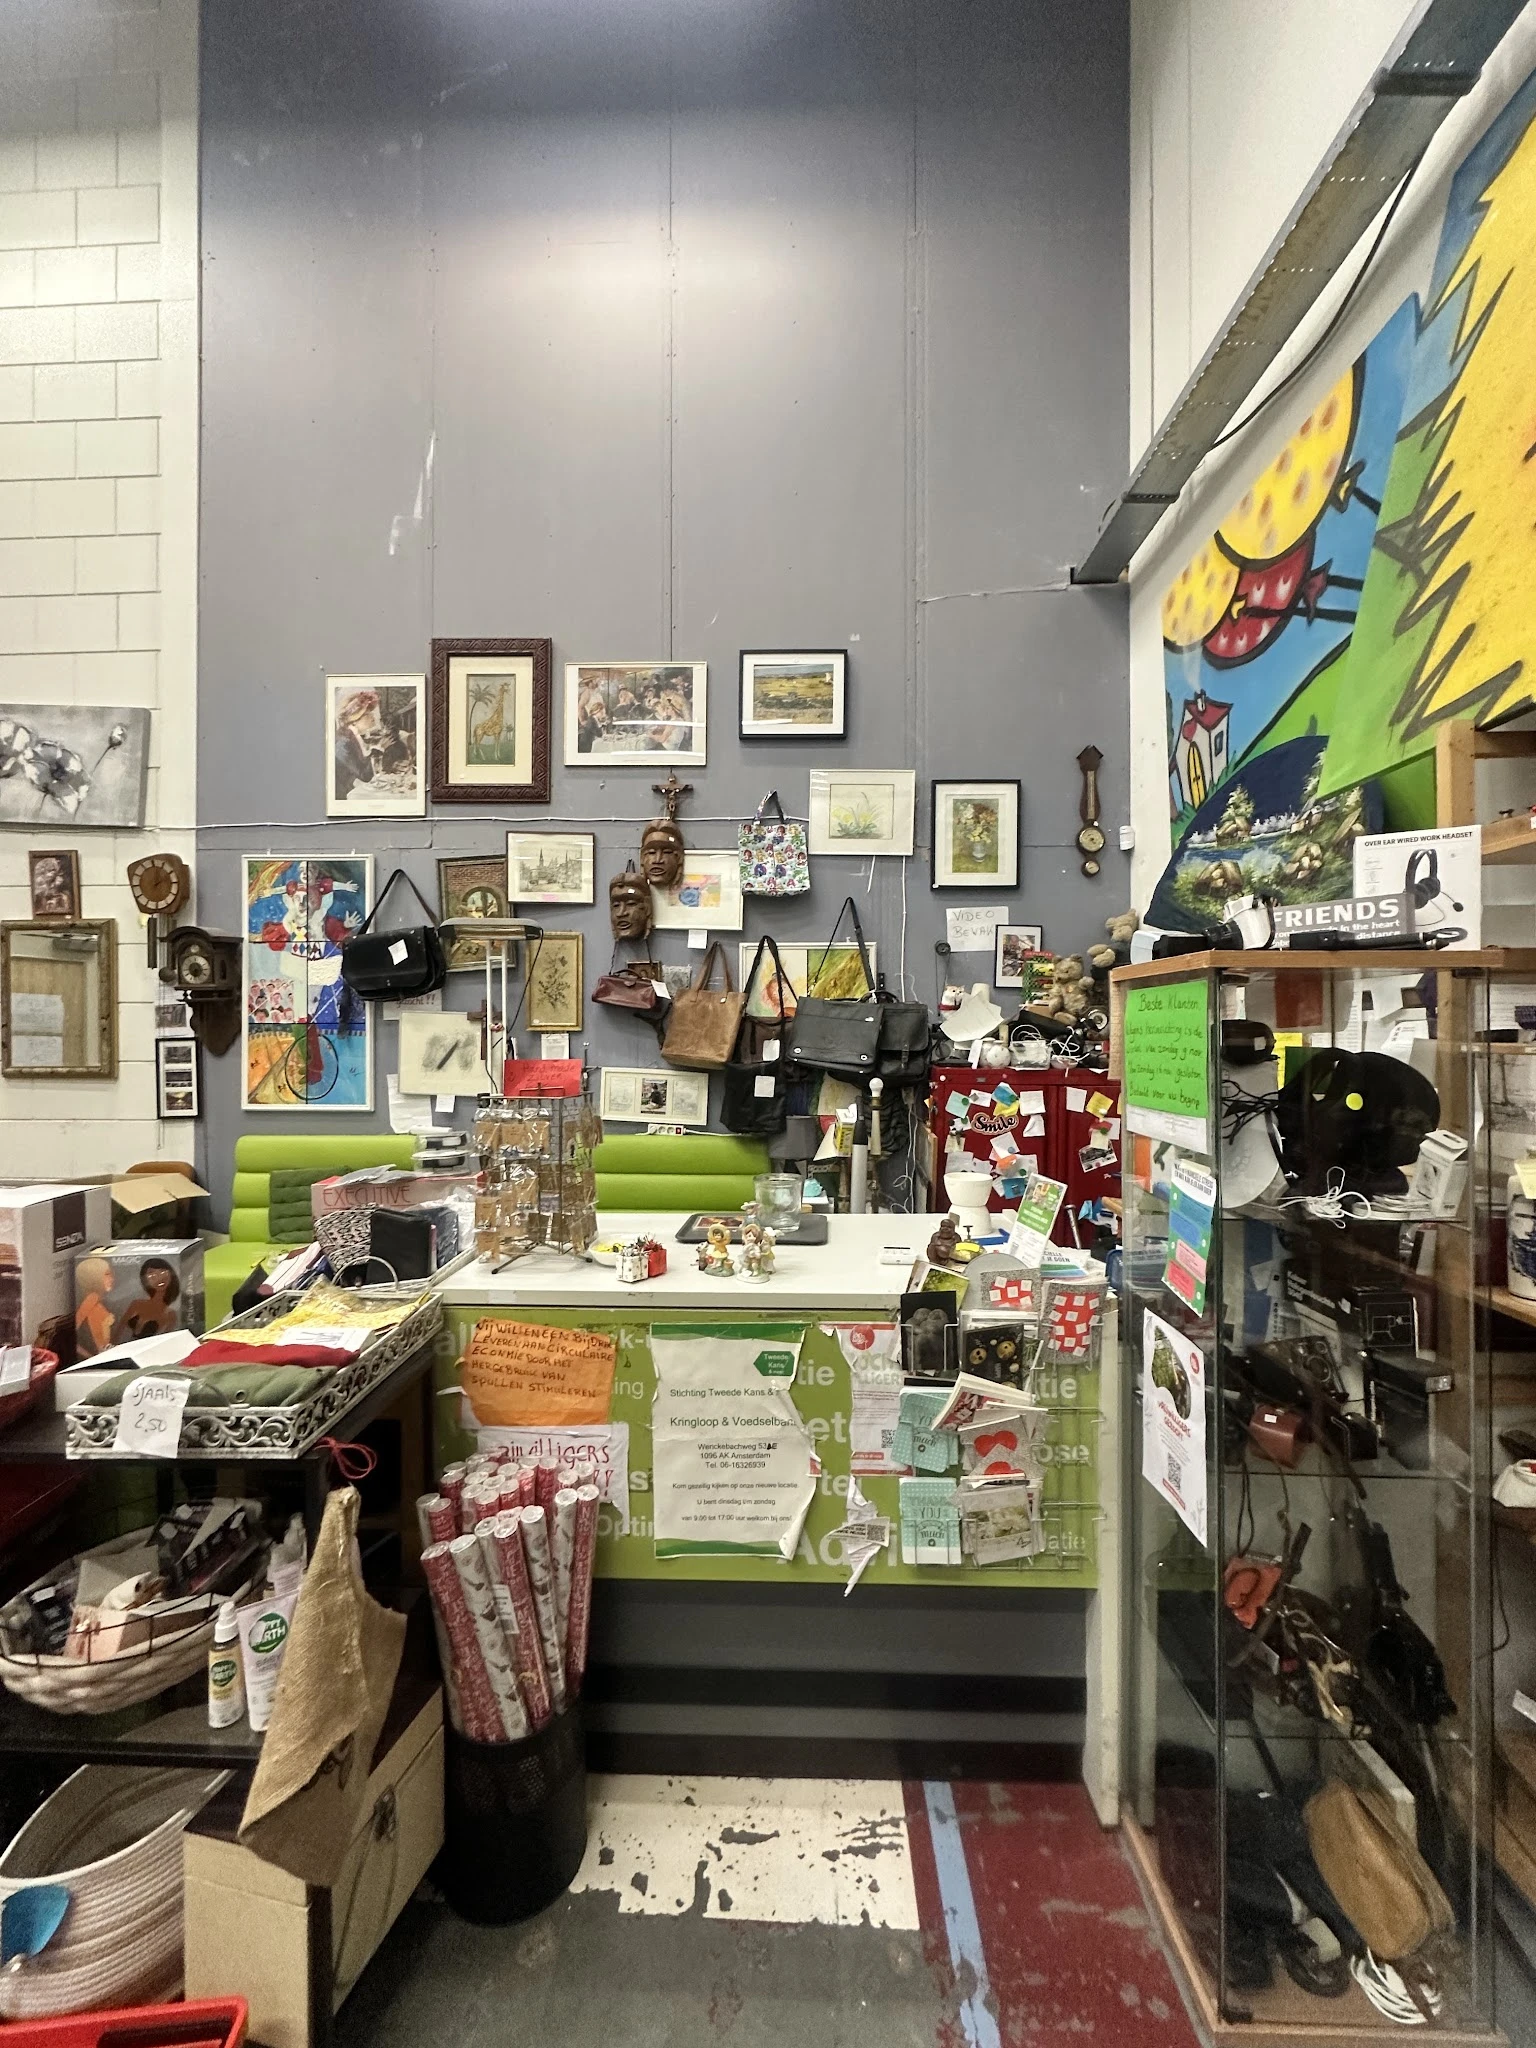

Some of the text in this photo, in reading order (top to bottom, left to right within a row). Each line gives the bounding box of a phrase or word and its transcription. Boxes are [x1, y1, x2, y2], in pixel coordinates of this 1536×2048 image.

[1364, 839, 1382, 847] OVER
[1397, 836, 1419, 844] WIRED
[1420, 834, 1441, 842] WORK
[1442, 831, 1473, 840] HEADSET
[1273, 898, 1400, 928] FRIENDS
[1352, 921, 1369, 931] the
[1371, 919, 1401, 929] heart
[1138, 993, 1164, 1012] Beste
[974, 1115, 1016, 1132] Smile
[323, 1186, 411, 1207] EXECUTIVE
[763, 1353, 790, 1361] Tweede
[767, 1361, 786, 1369] Kans
[541, 1371, 567, 1382] VAN
[797, 1358, 836, 1387] tie
[613, 1376, 644, 1400] ing
[670, 1388, 706, 1399] Stichting
[709, 1388, 741, 1397] Tweede
[744, 1387, 765, 1396] Kans
[767, 1387, 774, 1395] &
[670, 1417, 718, 1429] Kringloop
[721, 1417, 729, 1426] &
[697, 1443, 757, 1451] Wenckebachweg
[718, 1498, 742, 1506] dinsdag
[919, 1506, 942, 1519] YOU
[770, 1515, 778, 1523] bij
